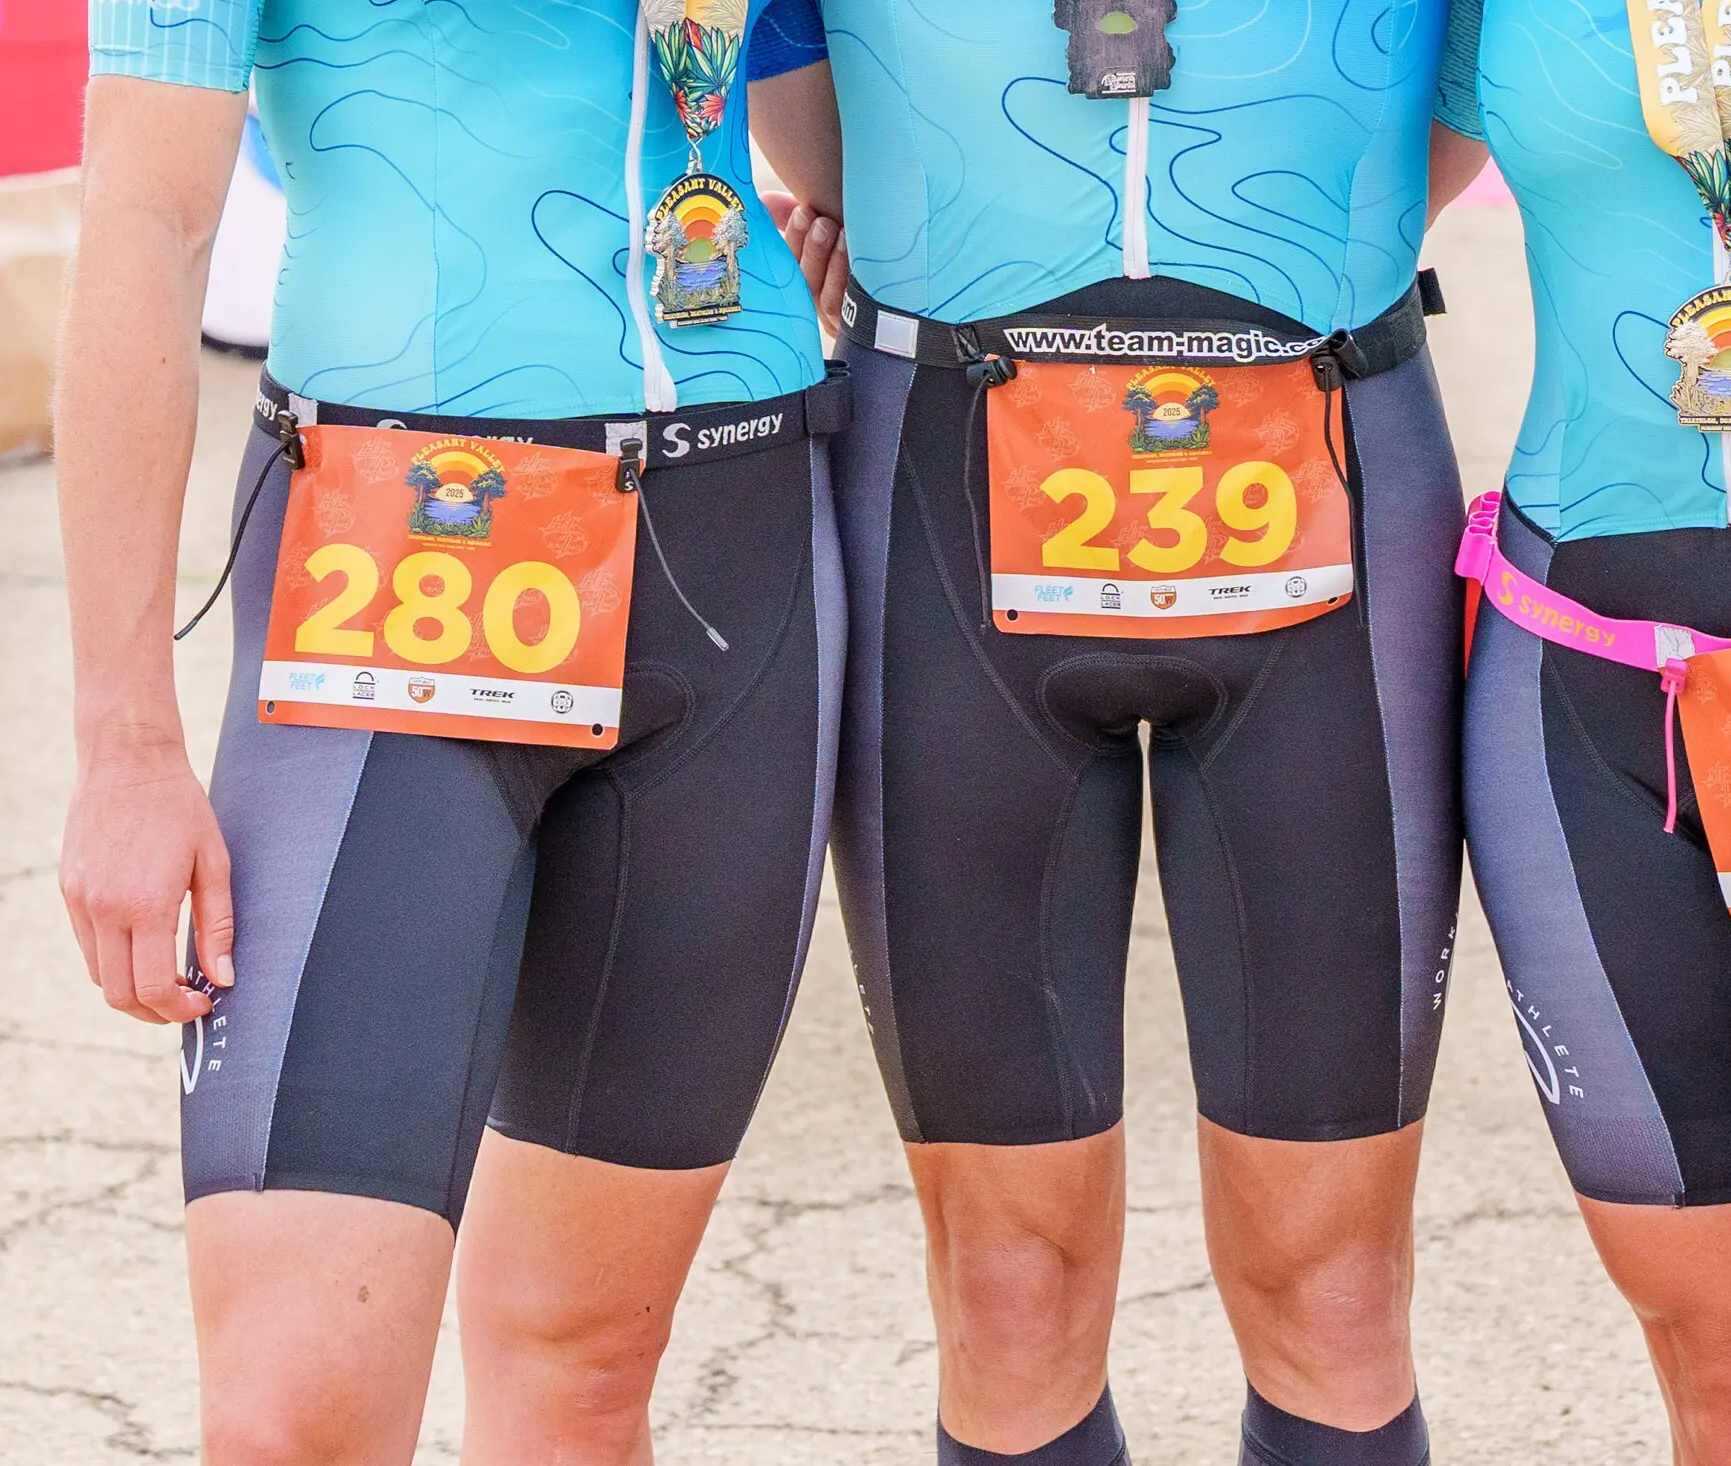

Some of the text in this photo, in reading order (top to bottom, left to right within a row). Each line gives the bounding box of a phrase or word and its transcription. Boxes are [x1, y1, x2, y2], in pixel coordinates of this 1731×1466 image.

[655, 177, 746, 222] PLEASANT VALLEY
[1163, 407, 1181, 417] 2025
[697, 413, 783, 451] synergy
[411, 438, 467, 466] PLEASANT
[470, 440, 506, 473] VALLEY
[445, 487, 464, 499] 2025
[1039, 460, 1297, 574] 239
[1034, 585, 1064, 595] FLEET
[1208, 585, 1252, 596] TREK
[1037, 593, 1062, 603] FEET
[294, 543, 582, 674] 280
[1518, 596, 1617, 648] synergy
[289, 672, 316, 683] FLEET
[290, 681, 314, 691] FEET
[470, 687, 516, 700] TREK
